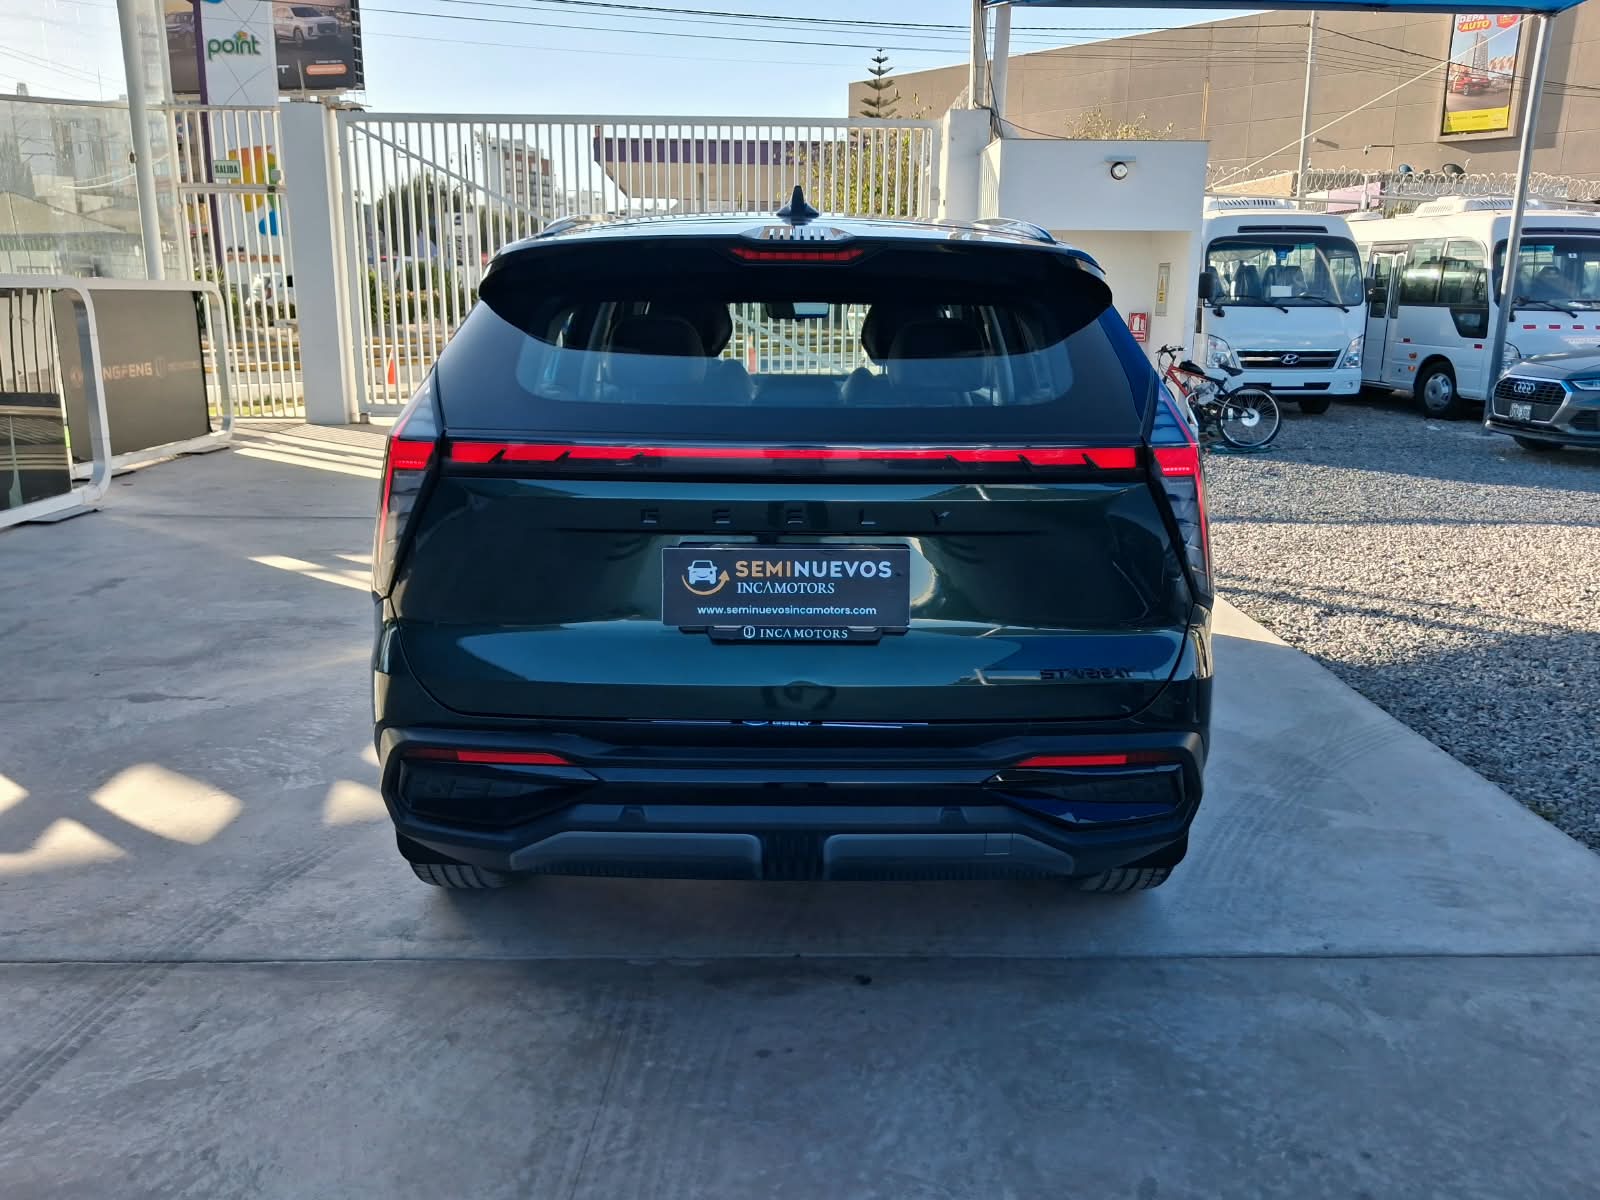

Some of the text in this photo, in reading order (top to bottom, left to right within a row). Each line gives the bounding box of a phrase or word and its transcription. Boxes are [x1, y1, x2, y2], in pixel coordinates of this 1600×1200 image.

[1462, 20, 1490, 31] AUTO
[207, 31, 260, 61] point
[215, 165, 238, 173] SALIDA
[102, 362, 153, 379] NGFENG
[735, 560, 892, 578] SEMINUEVOS
[736, 581, 835, 594] INCAMOTORS
[697, 605, 877, 615] www.seminuevosincamotors.com
